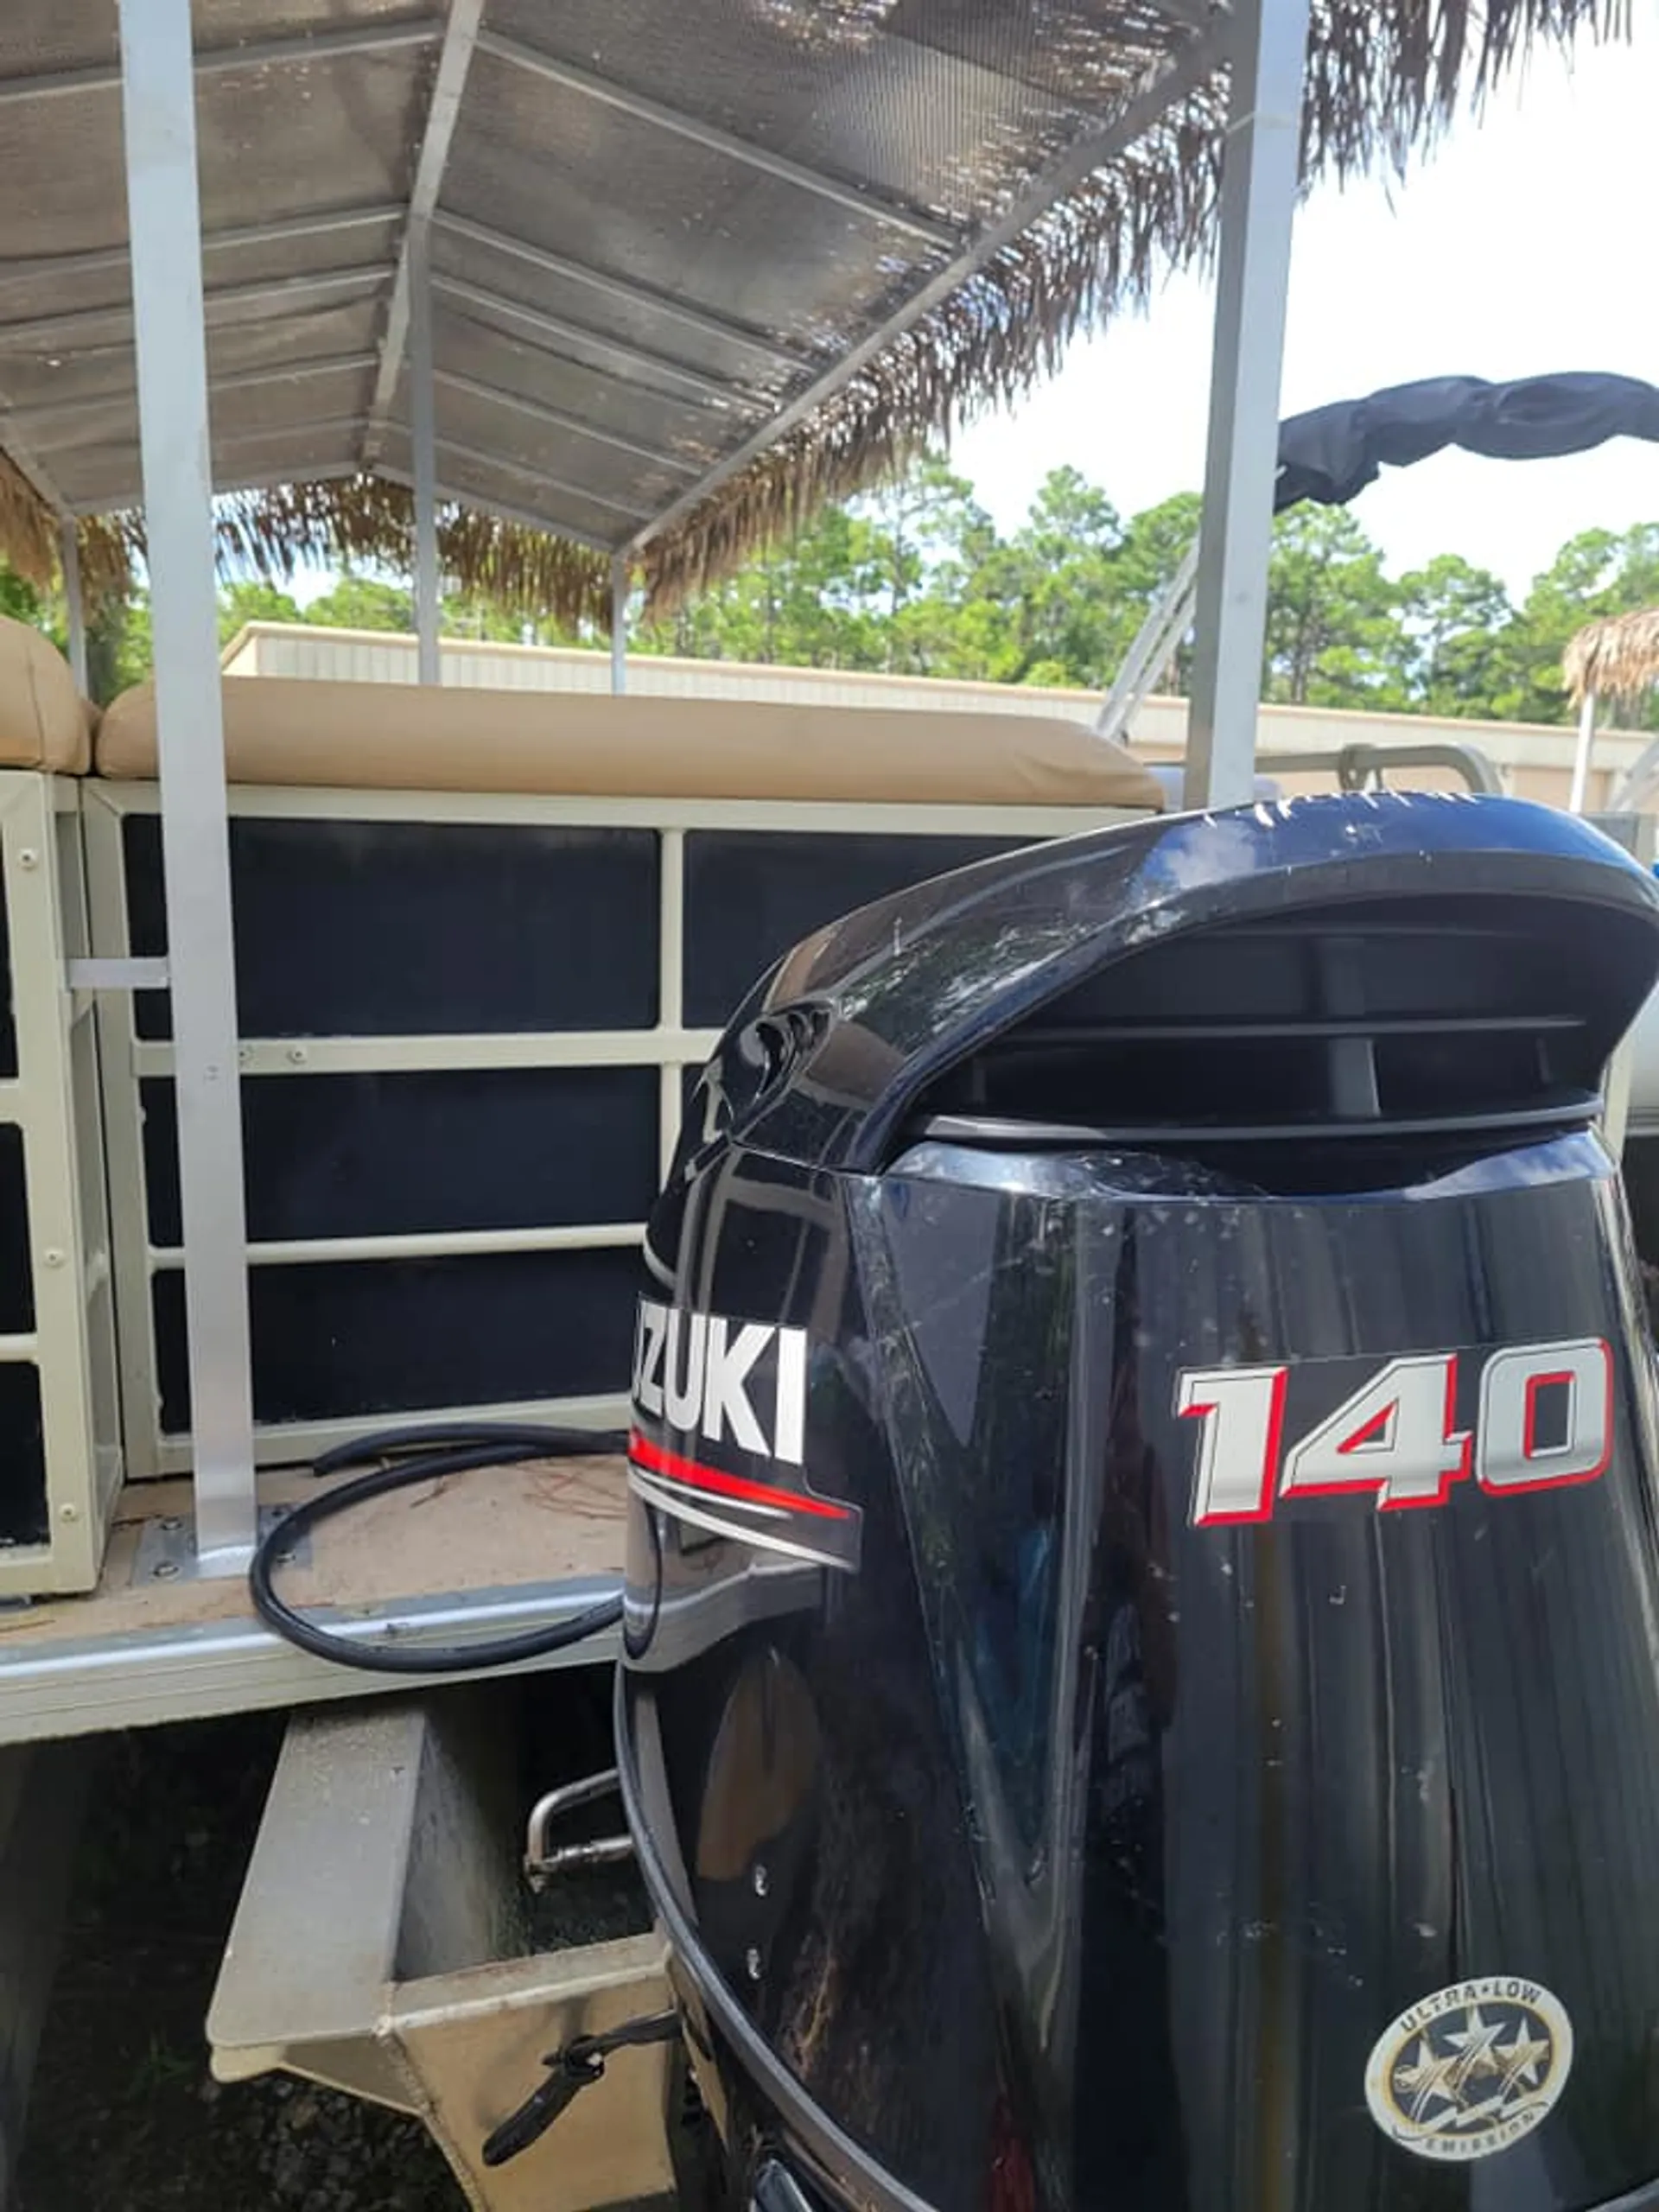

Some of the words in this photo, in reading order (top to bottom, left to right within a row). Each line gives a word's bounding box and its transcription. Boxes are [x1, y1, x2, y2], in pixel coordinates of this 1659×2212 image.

[1175, 1336, 1614, 1528] 140
[1398, 1987, 1478, 2033] ULTRA
[1493, 1980, 1543, 2004] LOW
